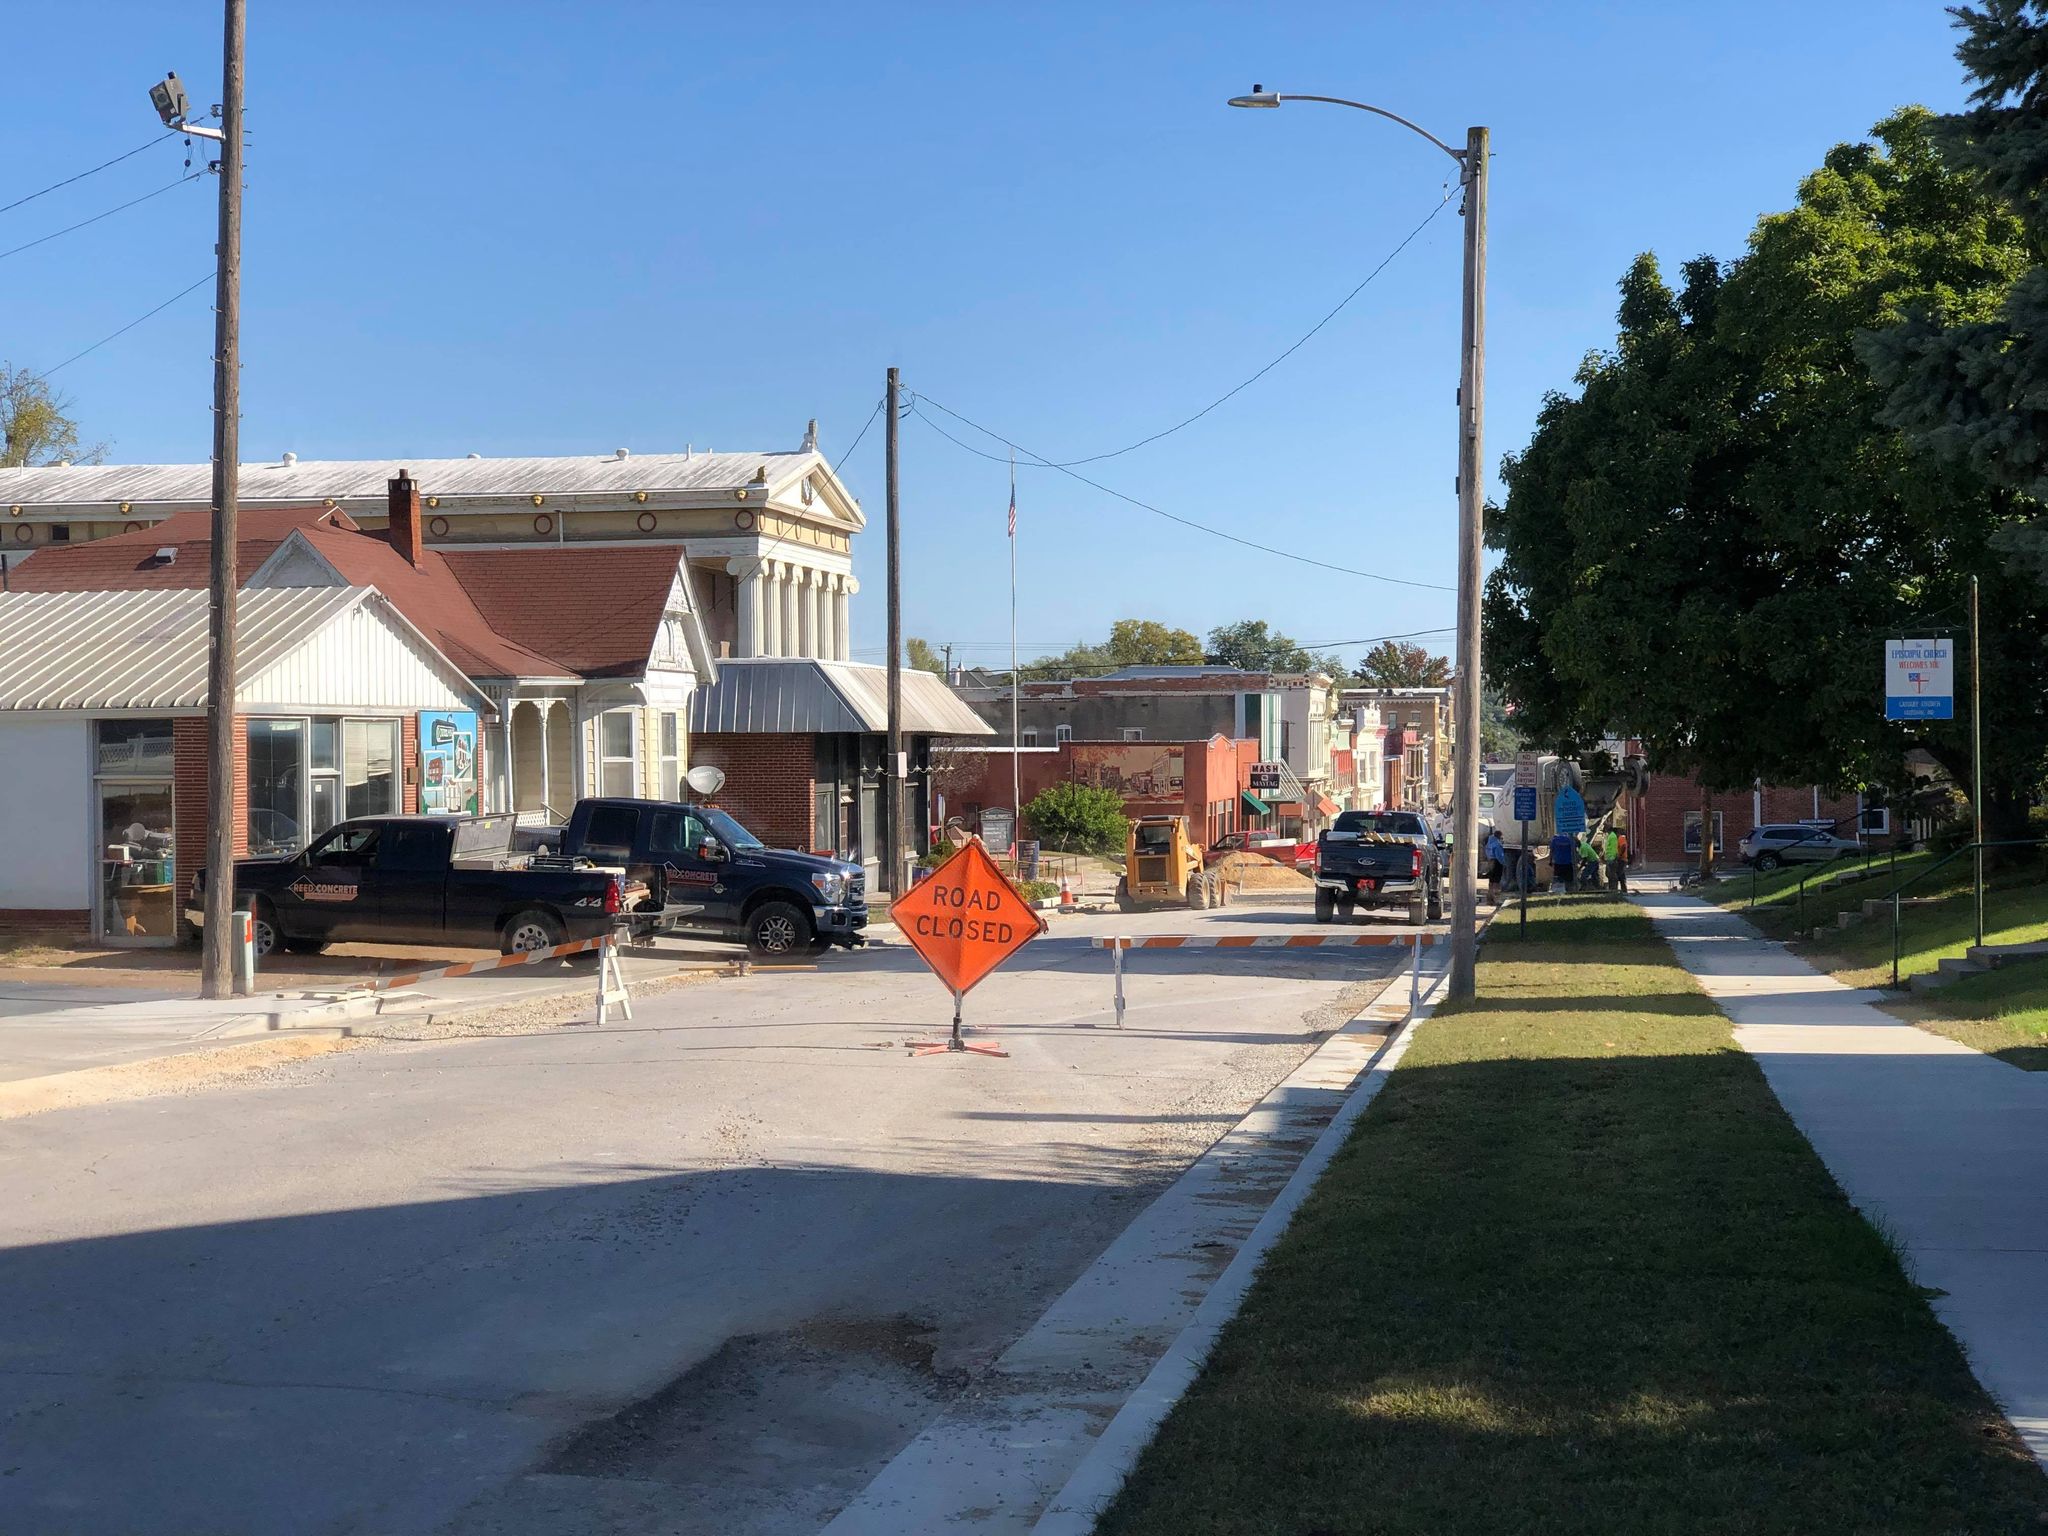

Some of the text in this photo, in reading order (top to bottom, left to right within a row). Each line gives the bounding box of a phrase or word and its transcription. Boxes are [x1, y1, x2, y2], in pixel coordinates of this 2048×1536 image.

[1892, 650, 1947, 659] EPISCOPAL CHURCH
[1899, 661, 1940, 669] WELCOMES YOU
[1252, 765, 1278, 773] MASH
[680, 870, 718, 883] CONCRETE
[293, 883, 359, 895] REED CONCRETE
[933, 885, 1001, 911] ROAD
[916, 914, 1013, 944] CLOSED
